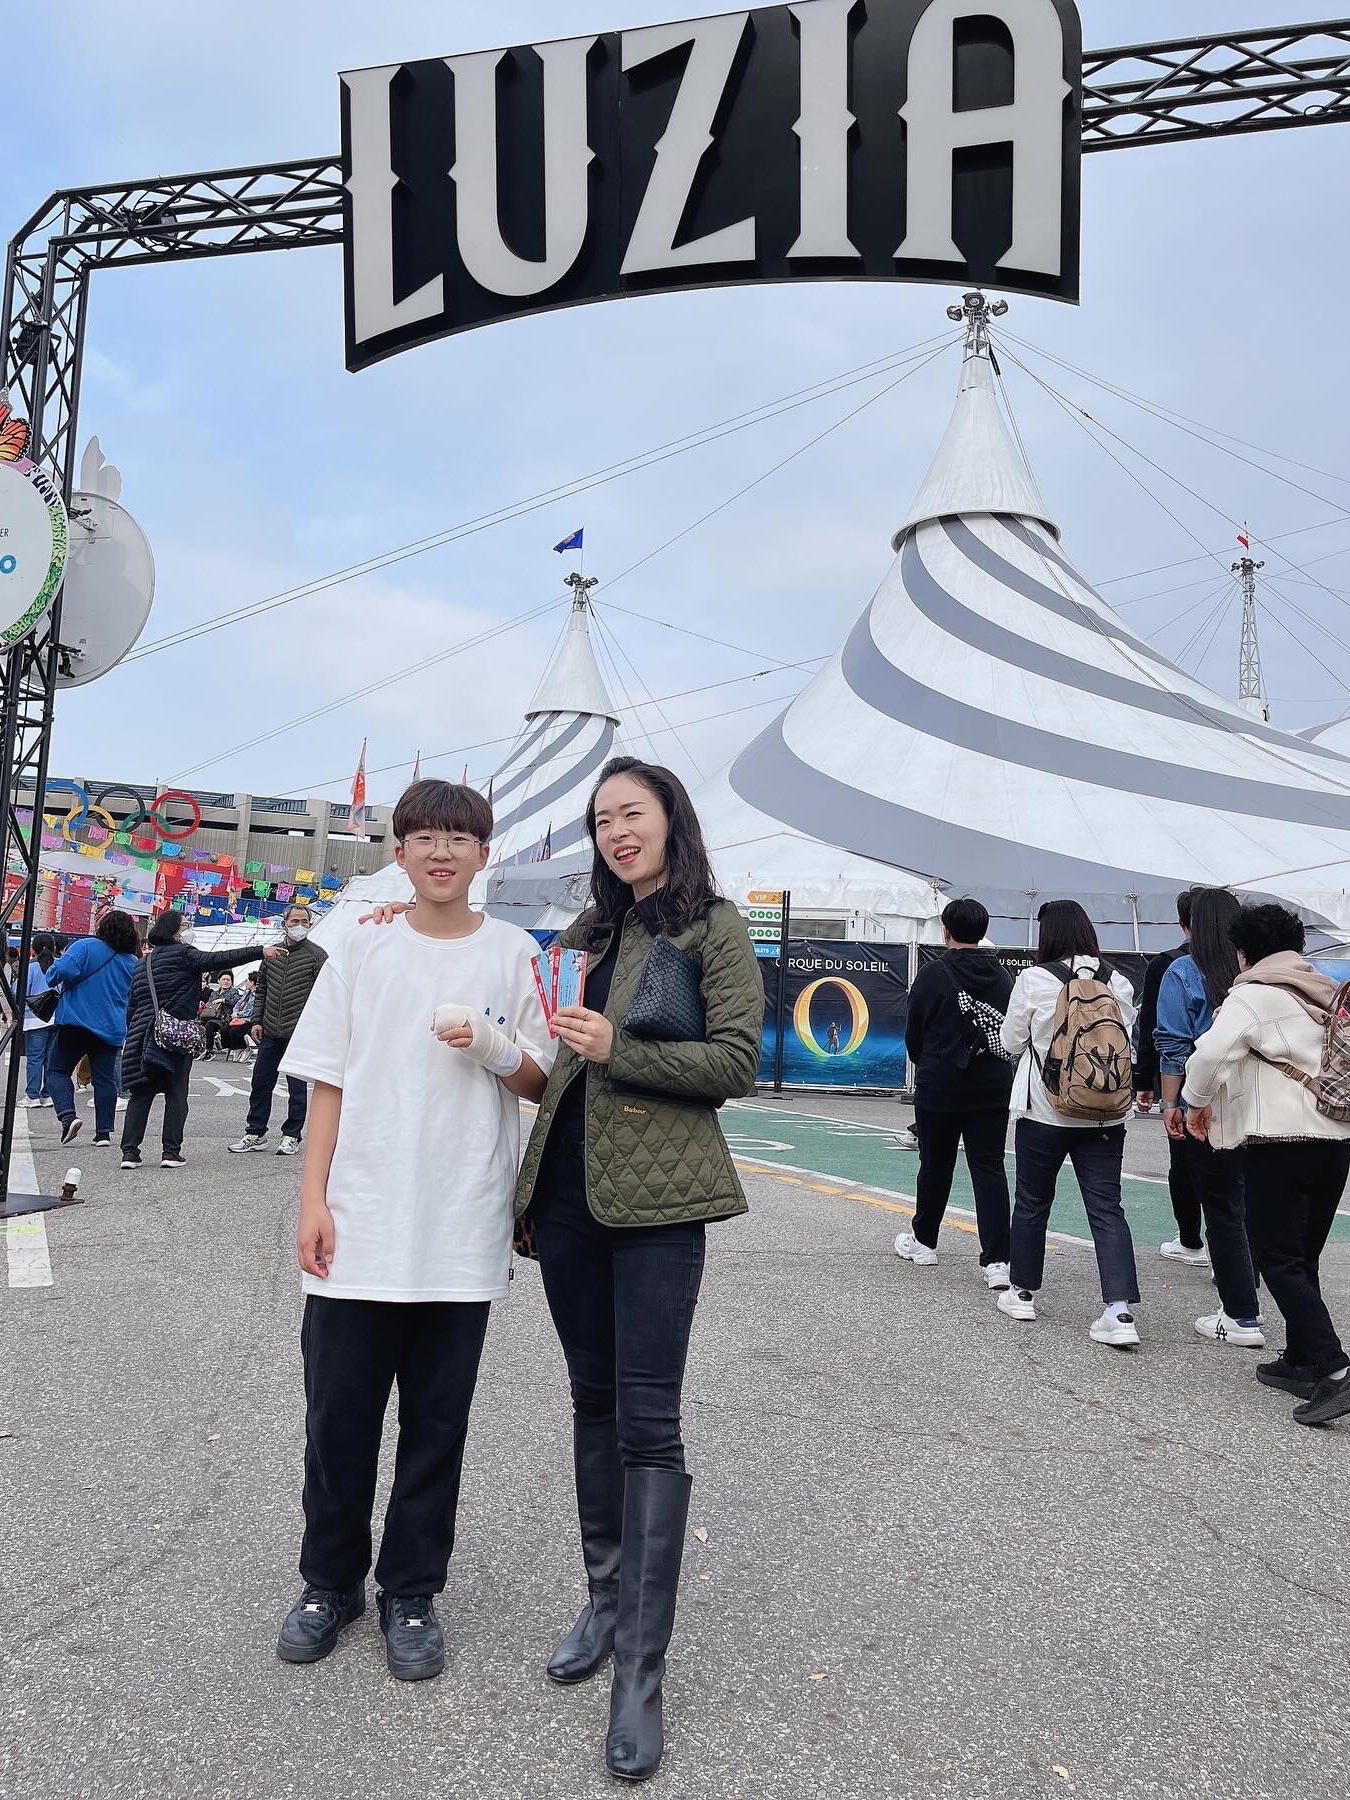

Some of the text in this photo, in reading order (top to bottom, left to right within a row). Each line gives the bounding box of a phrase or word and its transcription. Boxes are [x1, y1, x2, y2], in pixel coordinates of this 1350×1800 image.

[344, 0, 1073, 345] LUZIA
[775, 958, 889, 973] CRQUE DU SOLEIL
[1006, 959, 1034, 967] SOLEIL
[624, 1105, 647, 1115] Barbour
